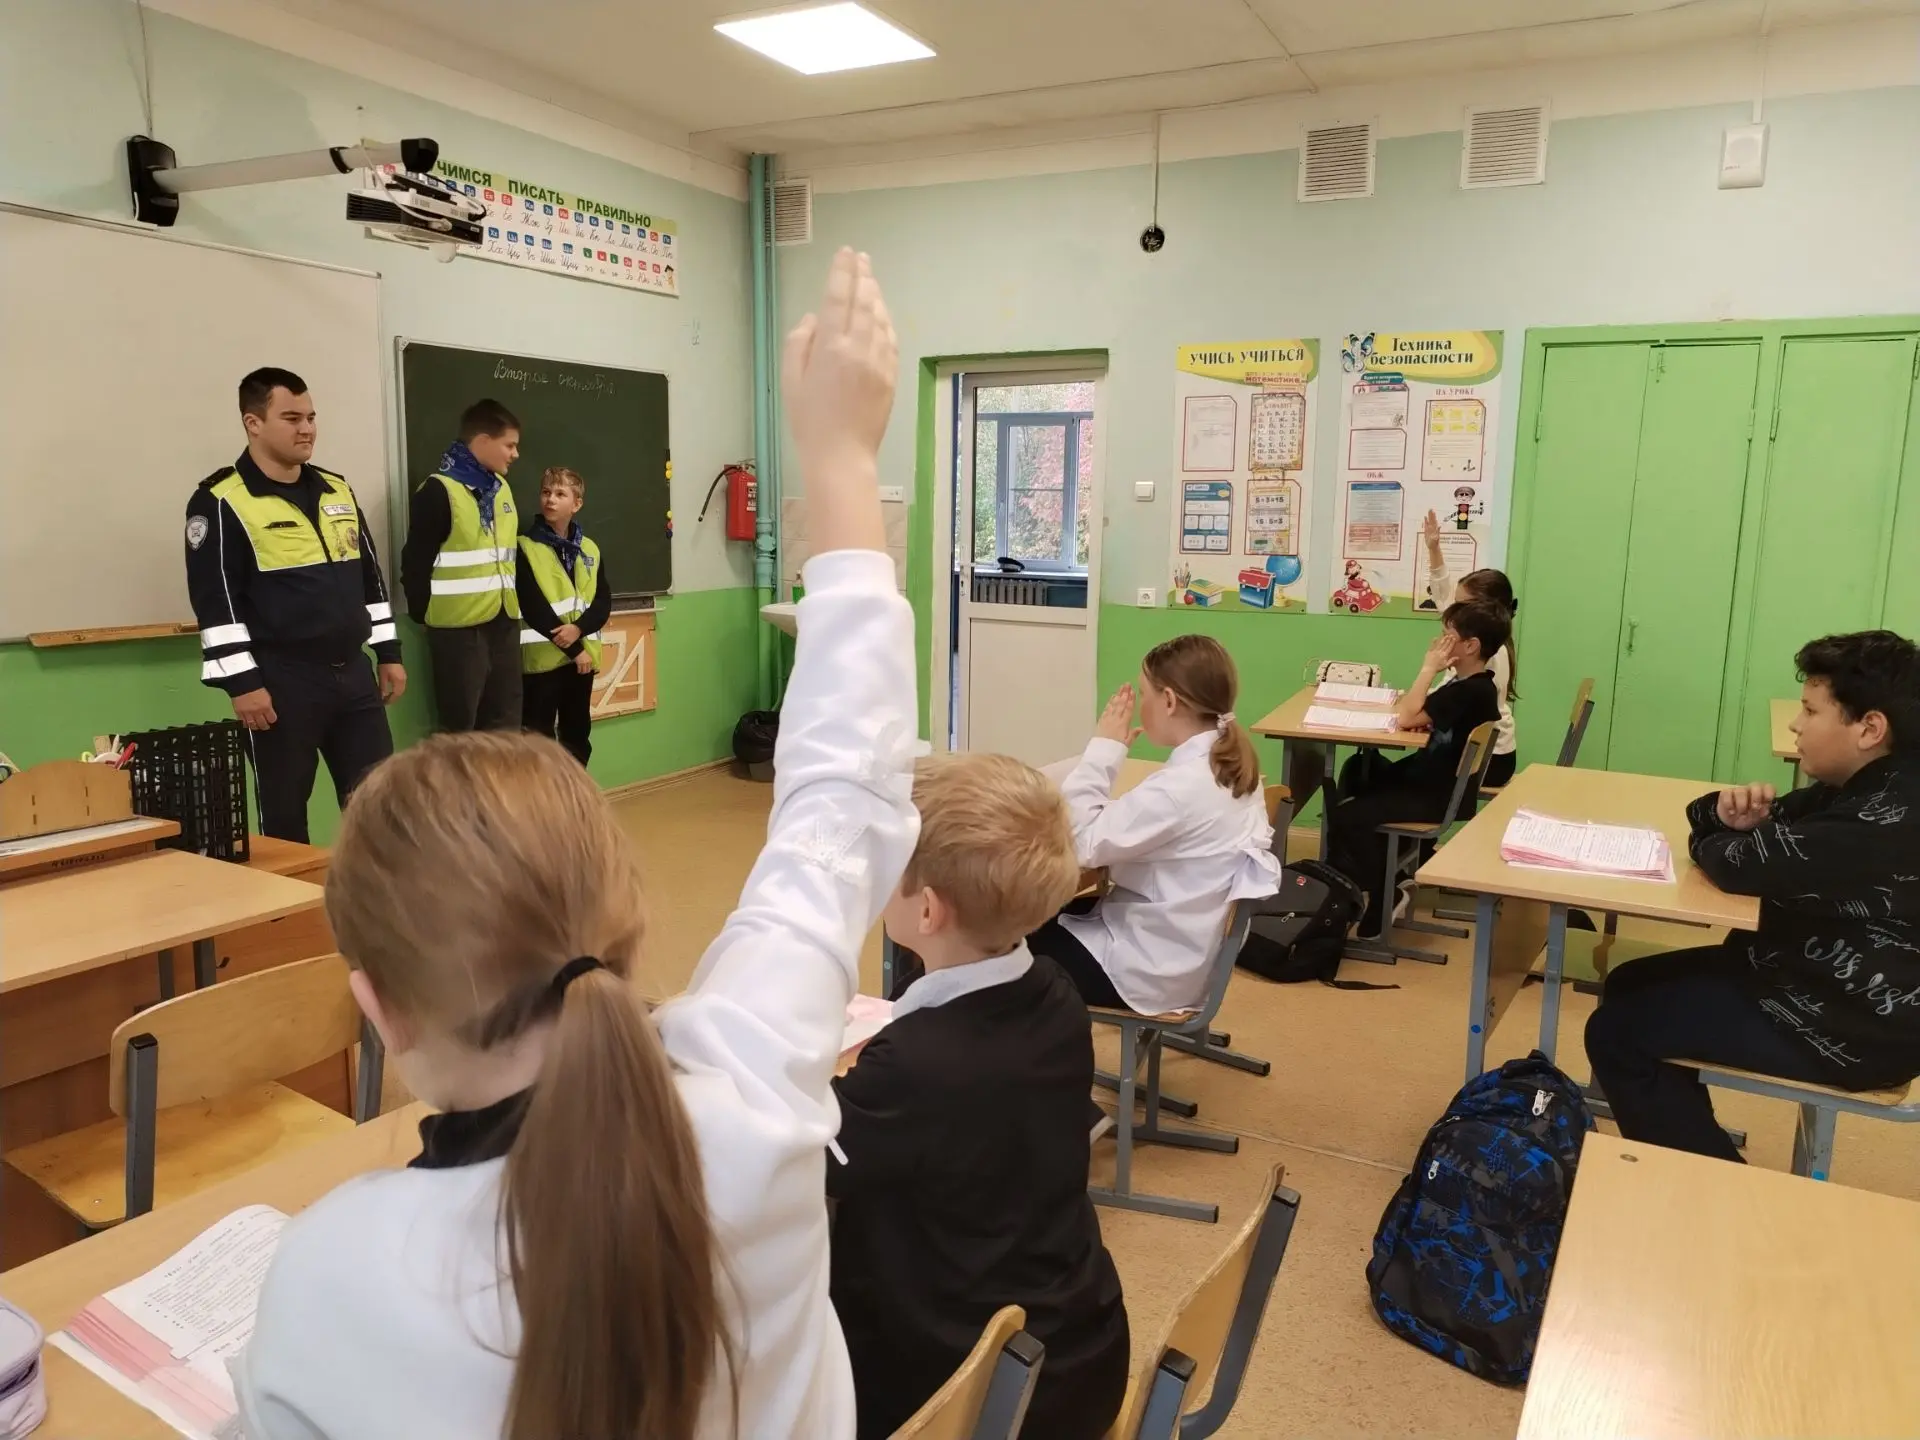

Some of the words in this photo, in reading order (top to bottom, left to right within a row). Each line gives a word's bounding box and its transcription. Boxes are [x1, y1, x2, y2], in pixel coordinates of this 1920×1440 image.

[436, 160, 492, 187] ЧИМСЯ
[508, 179, 565, 206] ПИСАТЬ
[577, 197, 651, 229] ПРАВИЛЬНО
[1392, 337, 1453, 352] Техника
[1190, 351, 1235, 366] УЧИСЬ
[1239, 348, 1305, 364] УЧИТЬСЯ
[1370, 352, 1474, 365] безопасности
[1449, 388, 1475, 396] УРОКЕ
